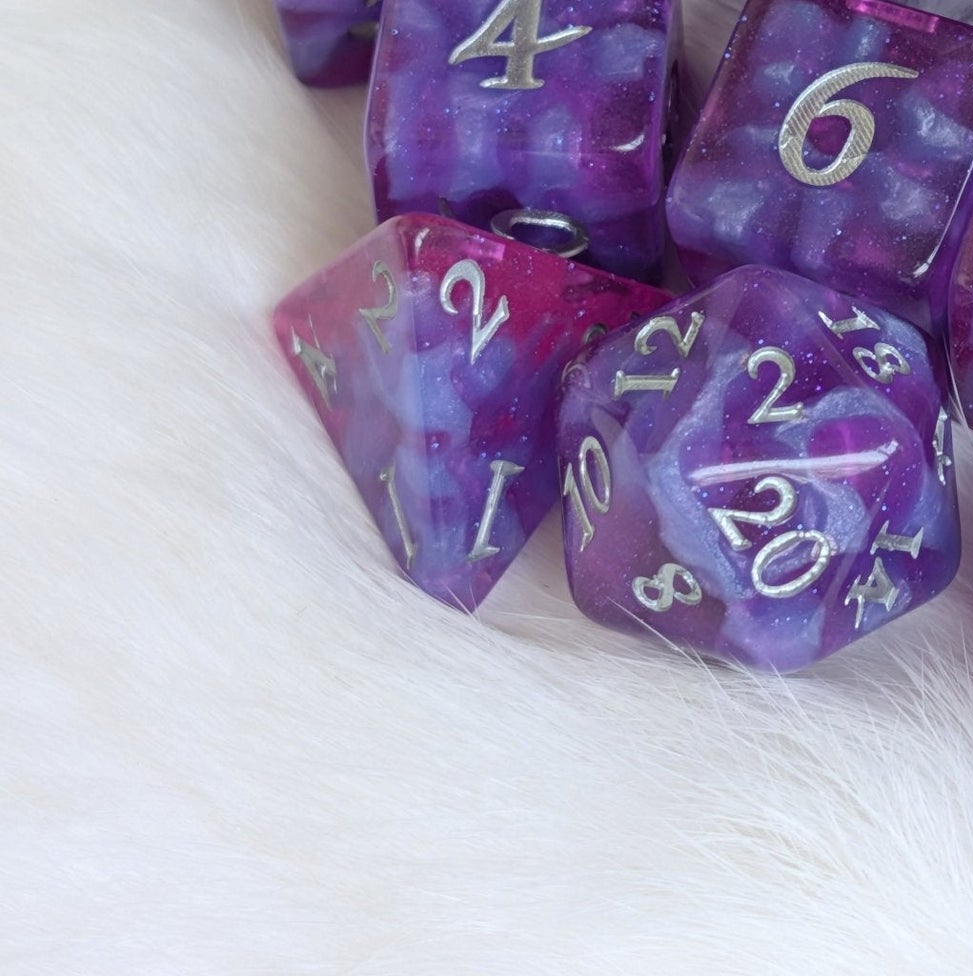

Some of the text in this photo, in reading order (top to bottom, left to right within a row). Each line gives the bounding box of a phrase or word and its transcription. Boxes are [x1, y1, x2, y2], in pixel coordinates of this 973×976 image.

[778, 62, 919, 186] 6
[359, 260, 398, 354] 2
[440, 259, 509, 364] 2
[614, 311, 705, 400] 12
[818, 306, 911, 384] 18
[747, 347, 805, 424] 2
[380, 458, 415, 569] 1
[468, 460, 524, 561] 1
[564, 435, 611, 552] 10
[708, 476, 833, 598] 20
[632, 562, 703, 611] 8
[844, 520, 925, 628] 14
